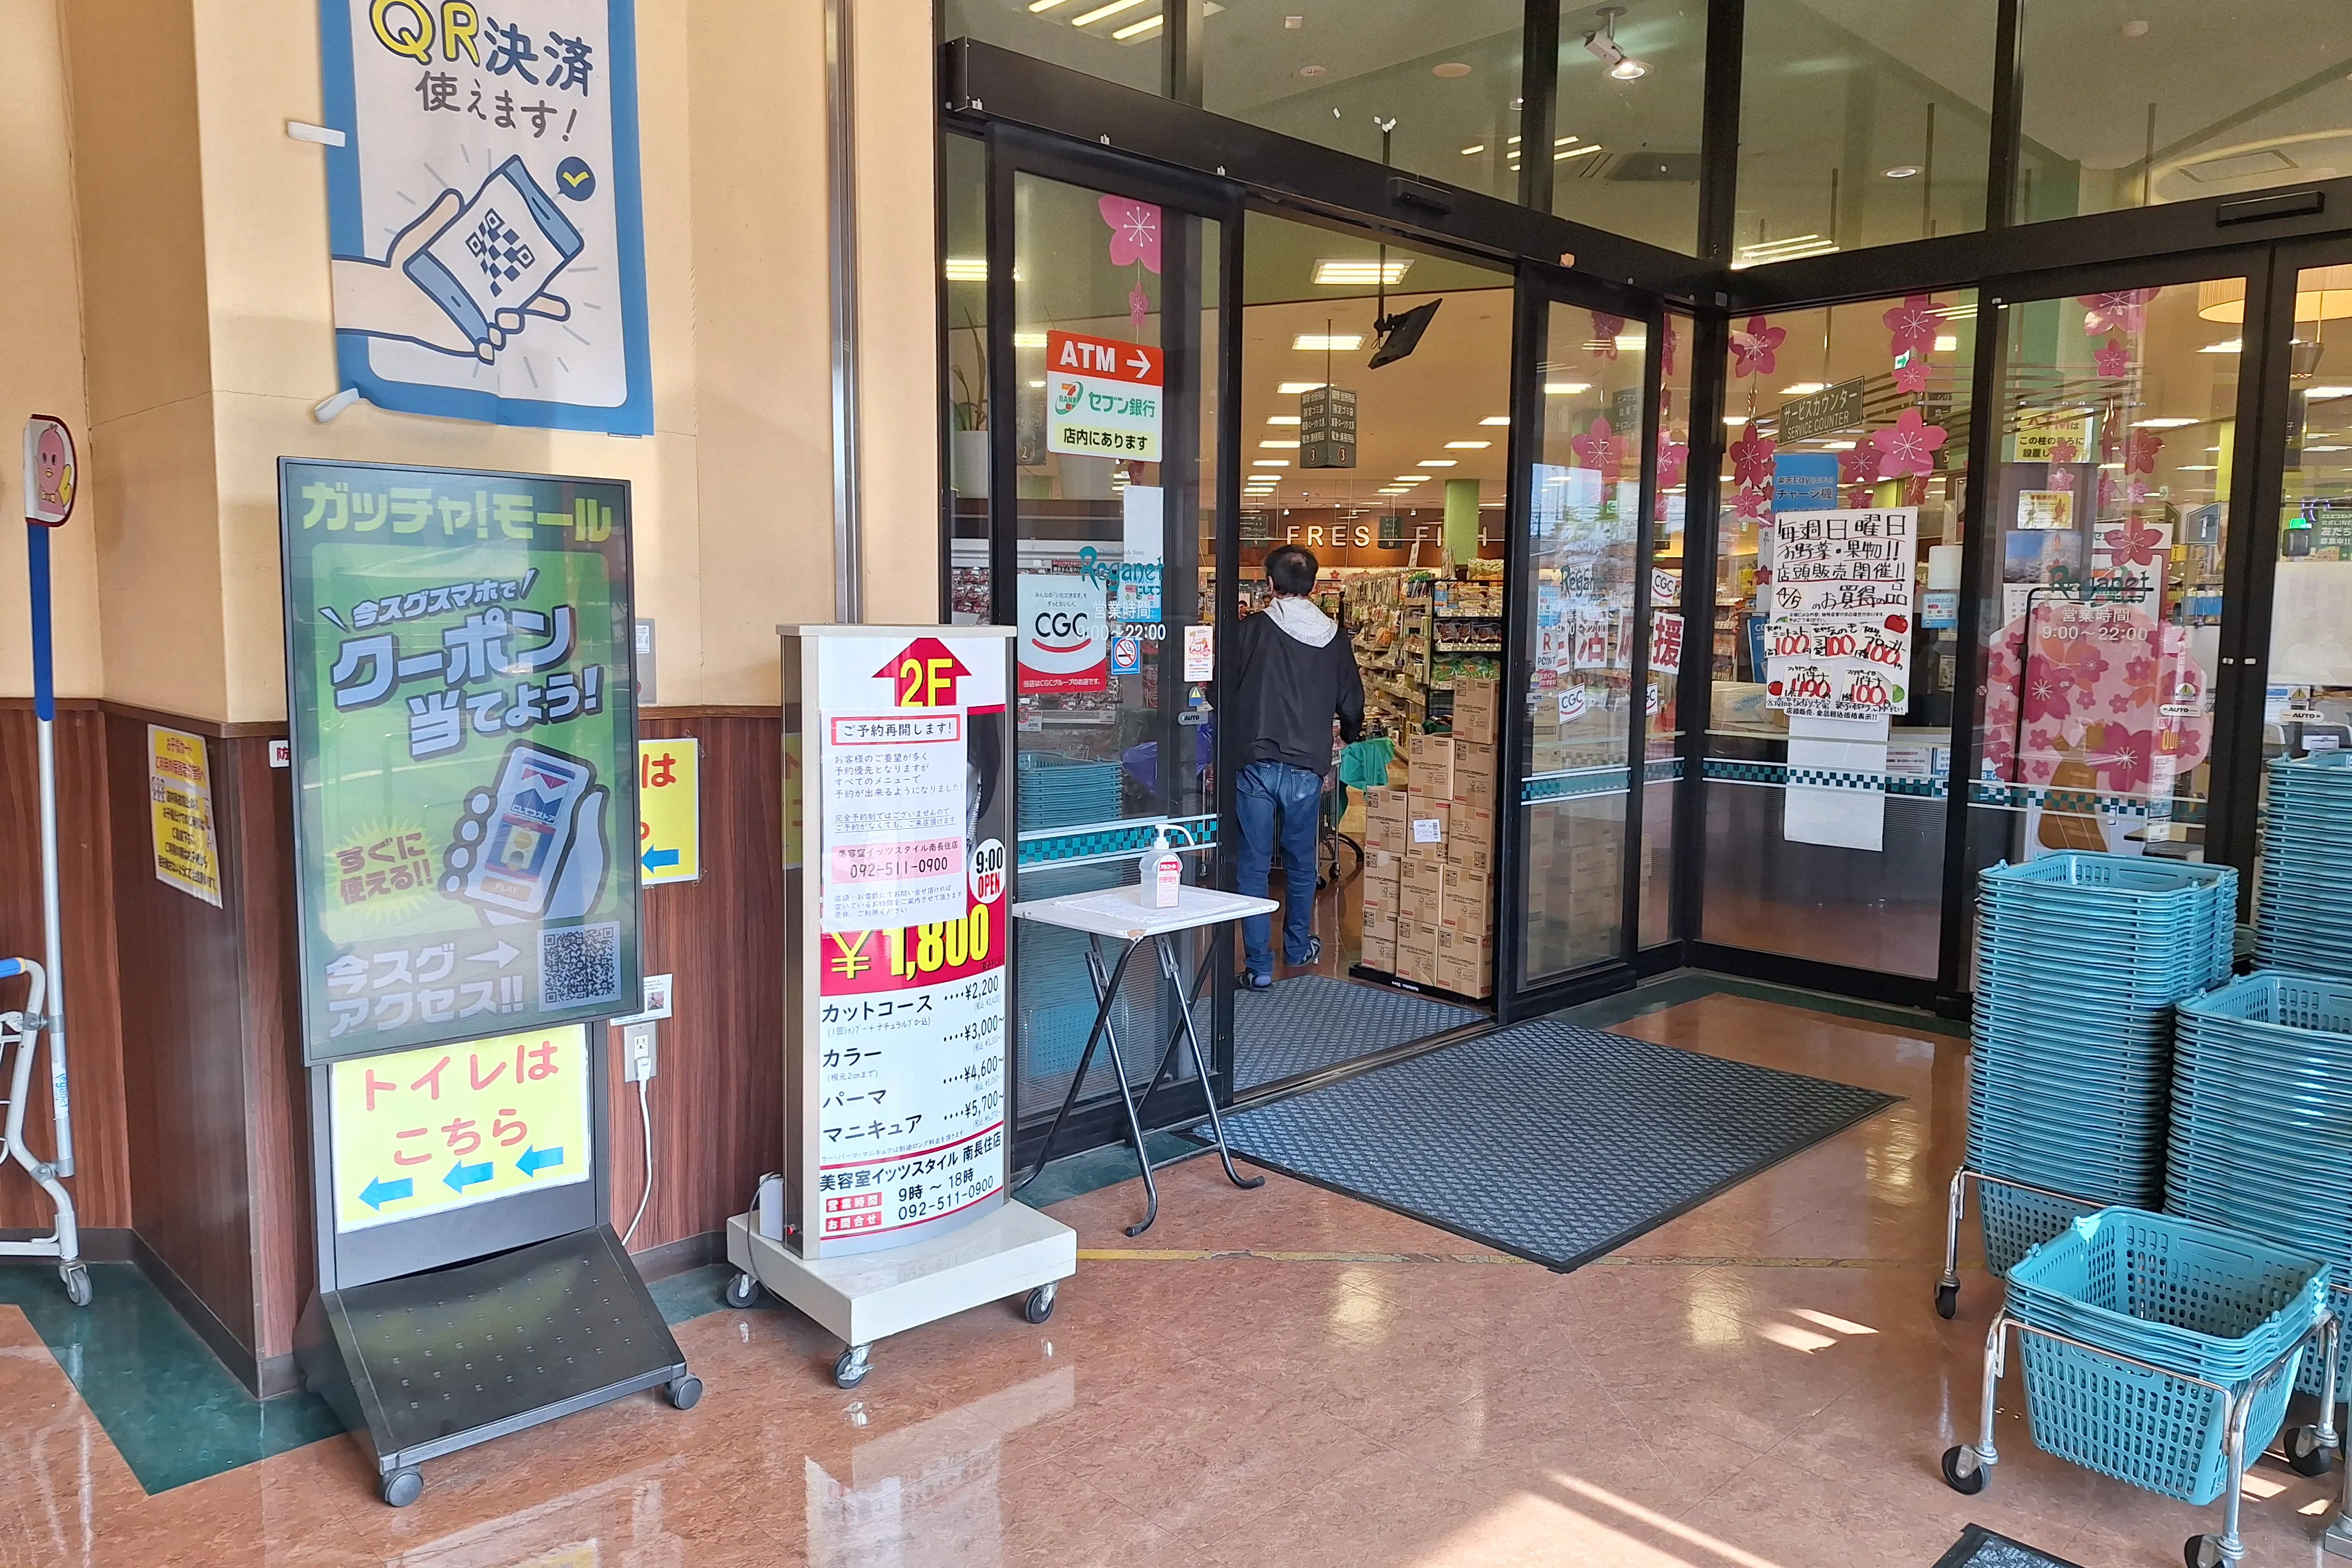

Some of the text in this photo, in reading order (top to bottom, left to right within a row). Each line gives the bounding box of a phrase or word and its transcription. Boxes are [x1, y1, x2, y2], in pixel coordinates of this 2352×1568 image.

[370, 0, 593, 96] QR決済
[415, 70, 577, 142] 使えます!
[1060, 341, 1115, 372] ATM
[1059, 395, 1078, 404] BANK
[1089, 391, 1155, 417] セブン銀行
[1784, 388, 1857, 425] サービスカウンター
[1788, 411, 1849, 440] SERVICE COUNTER
[1064, 428, 1147, 450] 店内にあります
[1310, 450, 1315, 461] 3
[1341, 448, 1345, 461] 3
[1943, 451, 1950, 462] 5
[1777, 488, 1832, 499] チャージ機
[302, 482, 611, 542] ガッチャ!モール
[1287, 525, 1370, 547] FRES
[1778, 514, 1906, 541] 毎週日曜日
[1078, 545, 1165, 591] Reganet
[1654, 575, 1674, 593] CGC
[352, 579, 517, 627] 今スグスマホで
[1093, 601, 1151, 619] 営業時間
[2063, 608, 2131, 623] 営業時間
[1035, 612, 1088, 638] CGC
[1653, 616, 1682, 669] 援
[1776, 634, 1810, 655] 100
[1866, 643, 1900, 665] 100
[333, 606, 571, 707] クーポン
[1537, 656, 1556, 665] POINT
[900, 658, 953, 707] 2F
[1850, 684, 1886, 706] 100
[411, 666, 601, 756] 当てよう!
[1562, 690, 1583, 708] CGC
[843, 722, 952, 737] ご予約再開します!
[834, 752, 928, 764] お客様のご要望が多く
[834, 763, 929, 775] 予約優先となりますが
[835, 775, 921, 786] すべてのメニューで
[336, 832, 426, 874] すぐに
[976, 847, 1004, 874] 9:00
[850, 857, 948, 879] 092-511-0900
[340, 859, 434, 906] 使える!!
[495, 882, 518, 895] PLAY
[978, 872, 1001, 898] OPEN
[327, 943, 455, 995] 今スグ
[327, 975, 523, 1038] アクセス!!
[822, 975, 999, 1023] カットコース ¥2,200
[823, 1047, 882, 1068] カラー
[365, 1041, 559, 1111] トイレは
[823, 1090, 887, 1109] パーマ
[394, 1109, 527, 1166] こちら
[823, 1114, 922, 1143] マニキュア
[820, 1131, 1001, 1192] 美容室イッツスタイル 南長住店
[827, 1195, 880, 1211] 営業時間
[899, 1175, 993, 1220] 092-511-0900
[827, 1214, 877, 1230] お問合せ
